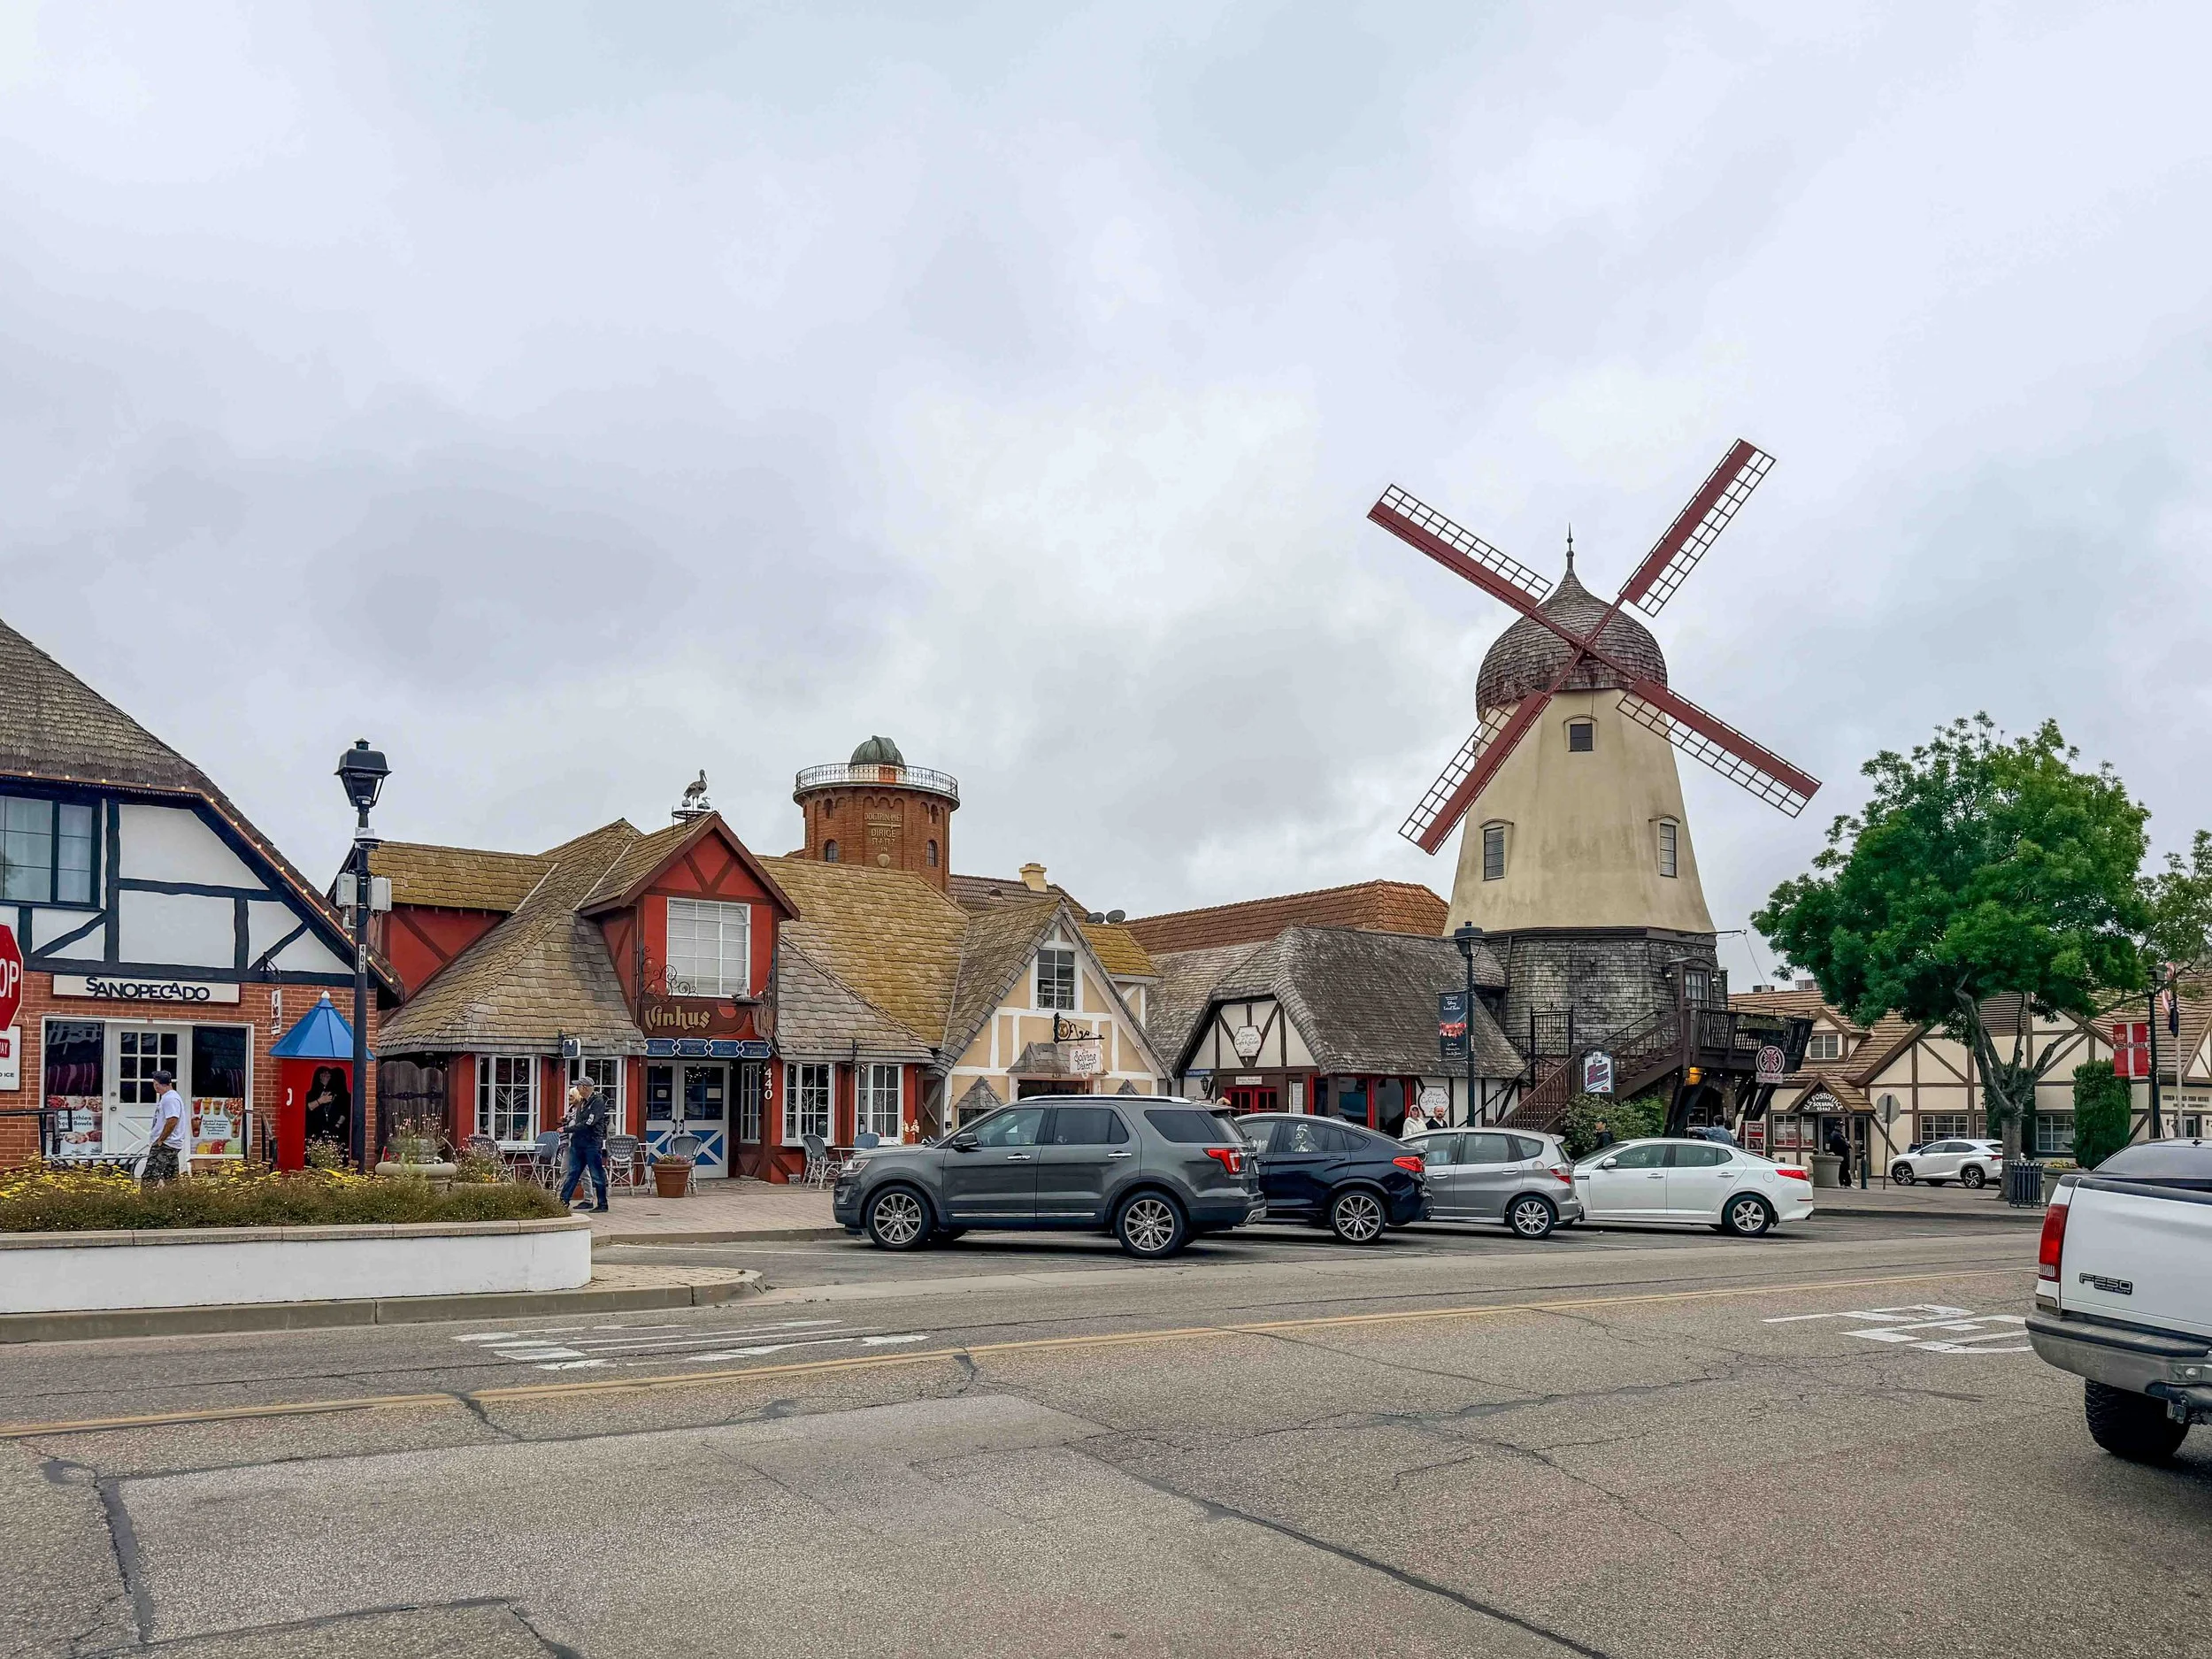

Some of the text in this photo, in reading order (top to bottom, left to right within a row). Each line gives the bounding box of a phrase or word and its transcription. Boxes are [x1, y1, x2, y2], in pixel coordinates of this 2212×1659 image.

[871, 828, 895, 838] DIRIGE
[0, 957, 19, 998] OP
[85, 976, 211, 1001] SANOPECADO
[644, 1005, 710, 1031] Vinhus
[1074, 1051, 1096, 1064] Solvang
[764, 1067, 773, 1100] 440
